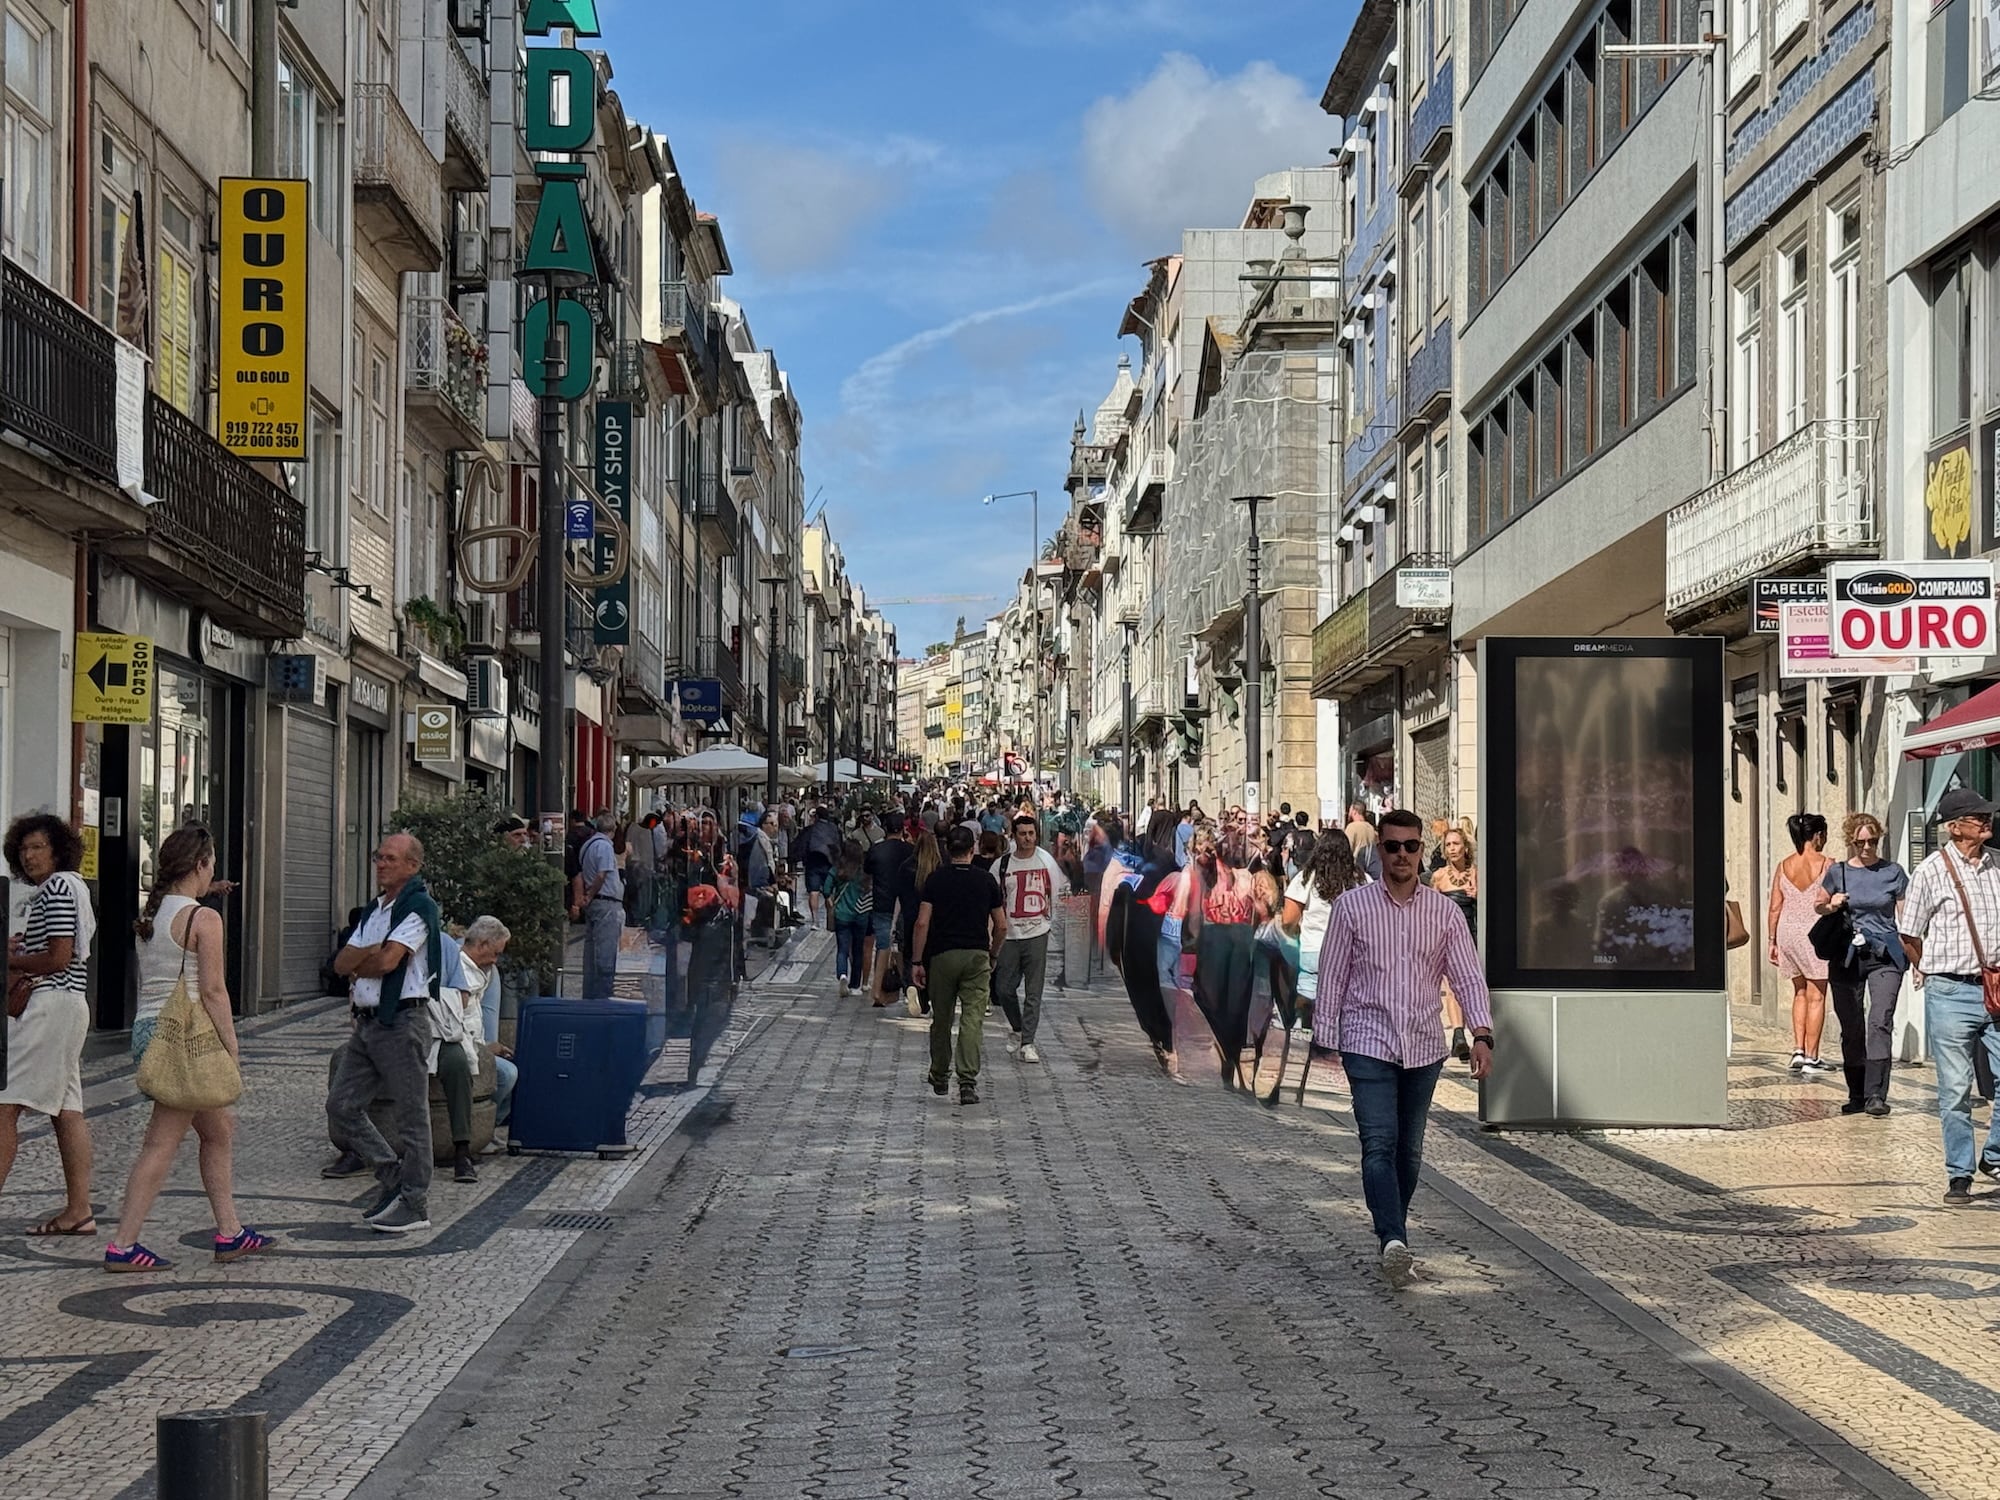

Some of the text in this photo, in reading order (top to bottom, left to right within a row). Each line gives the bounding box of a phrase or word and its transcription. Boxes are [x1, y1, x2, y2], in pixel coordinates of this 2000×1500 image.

[242, 187, 285, 357] OURO
[236, 370, 290, 383] OLD GOLD
[226, 421, 299, 435] 919 722 457
[226, 435, 299, 448] 222 000 350
[605, 416, 622, 475] SHOP
[1918, 581, 1985, 597] COMPRAMOS
[1841, 605, 1986, 650] OURO
[131, 642, 148, 696] COMPRO
[119, 697, 140, 705] Prata
[420, 731, 449, 740] essilor
